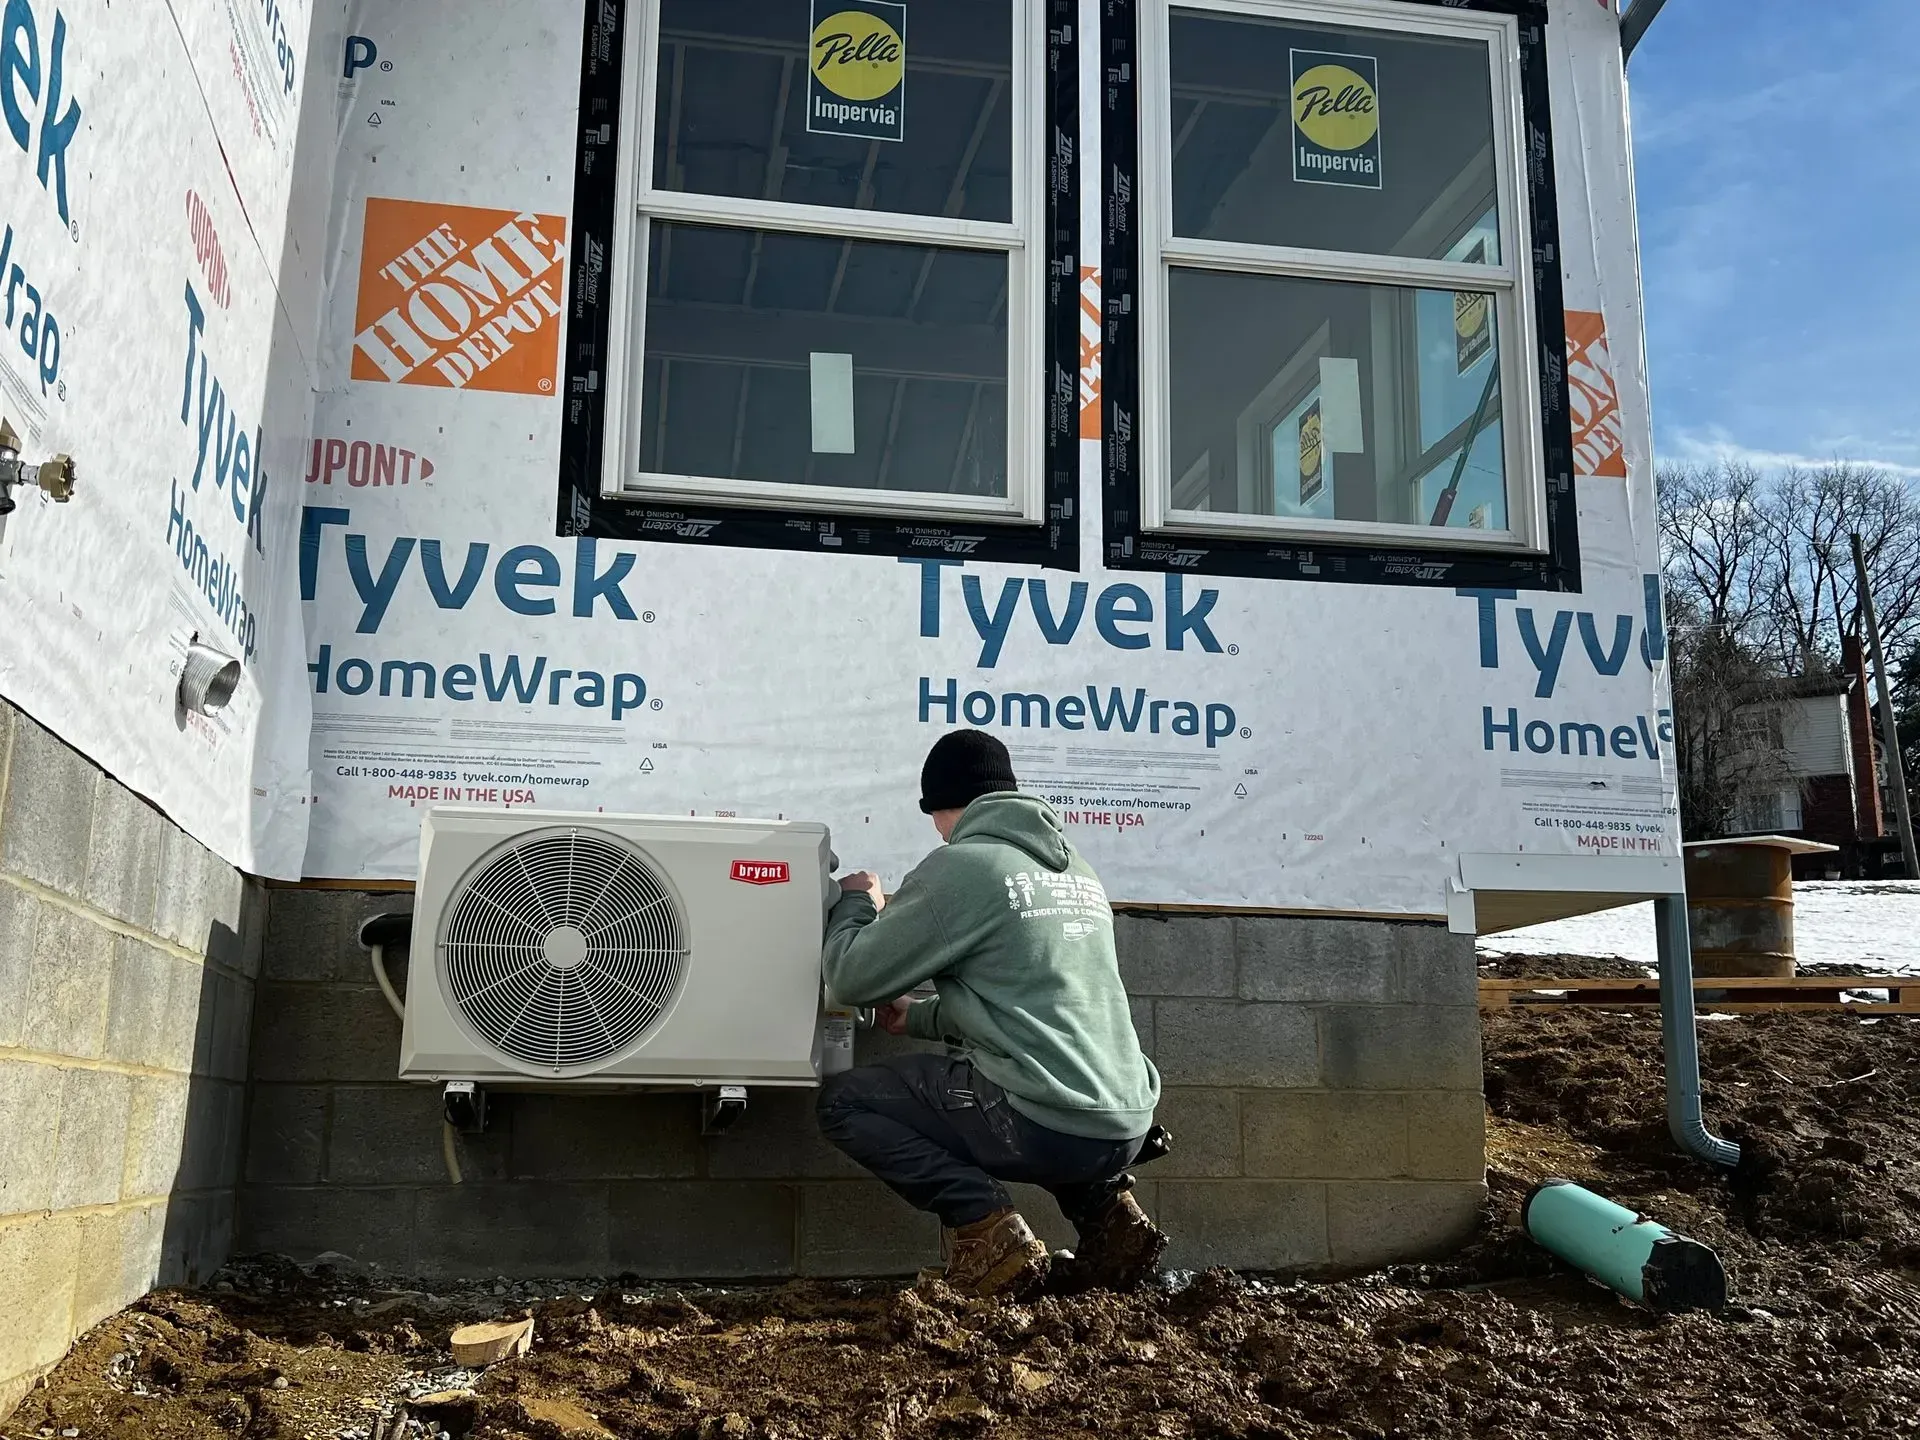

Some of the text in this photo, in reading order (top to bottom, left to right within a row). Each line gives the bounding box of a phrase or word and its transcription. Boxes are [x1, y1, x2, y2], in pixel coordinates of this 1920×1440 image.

[815, 32, 900, 70] Pella
[815, 96, 896, 125] Impervia
[1296, 85, 1375, 122] Pella
[1300, 146, 1375, 173] Impervia
[378, 222, 467, 291] THE
[353, 211, 567, 382] HOME
[433, 280, 561, 388] DEPOT
[181, 277, 268, 553] Tyvek
[166, 477, 256, 667] HomeWrap
[299, 506, 639, 634] Tyvek
[897, 556, 1225, 669] Tyvek
[918, 676, 1237, 748] HomeWrap
[336, 766, 590, 788] Call 1-800-448-9835 tyvek.com/homewrap
[388, 785, 536, 803] MADE IN THE USA
[1064, 811, 1145, 827] IN THE USA
[1079, 797, 1191, 812] tyvek.com/homewrap
[1534, 817, 1553, 827] Call
[1554, 818, 1631, 831] 1-800-448-9835
[1578, 835, 1618, 849] MADE
[1622, 837, 1636, 850] IN
[740, 865, 781, 879] bryant
